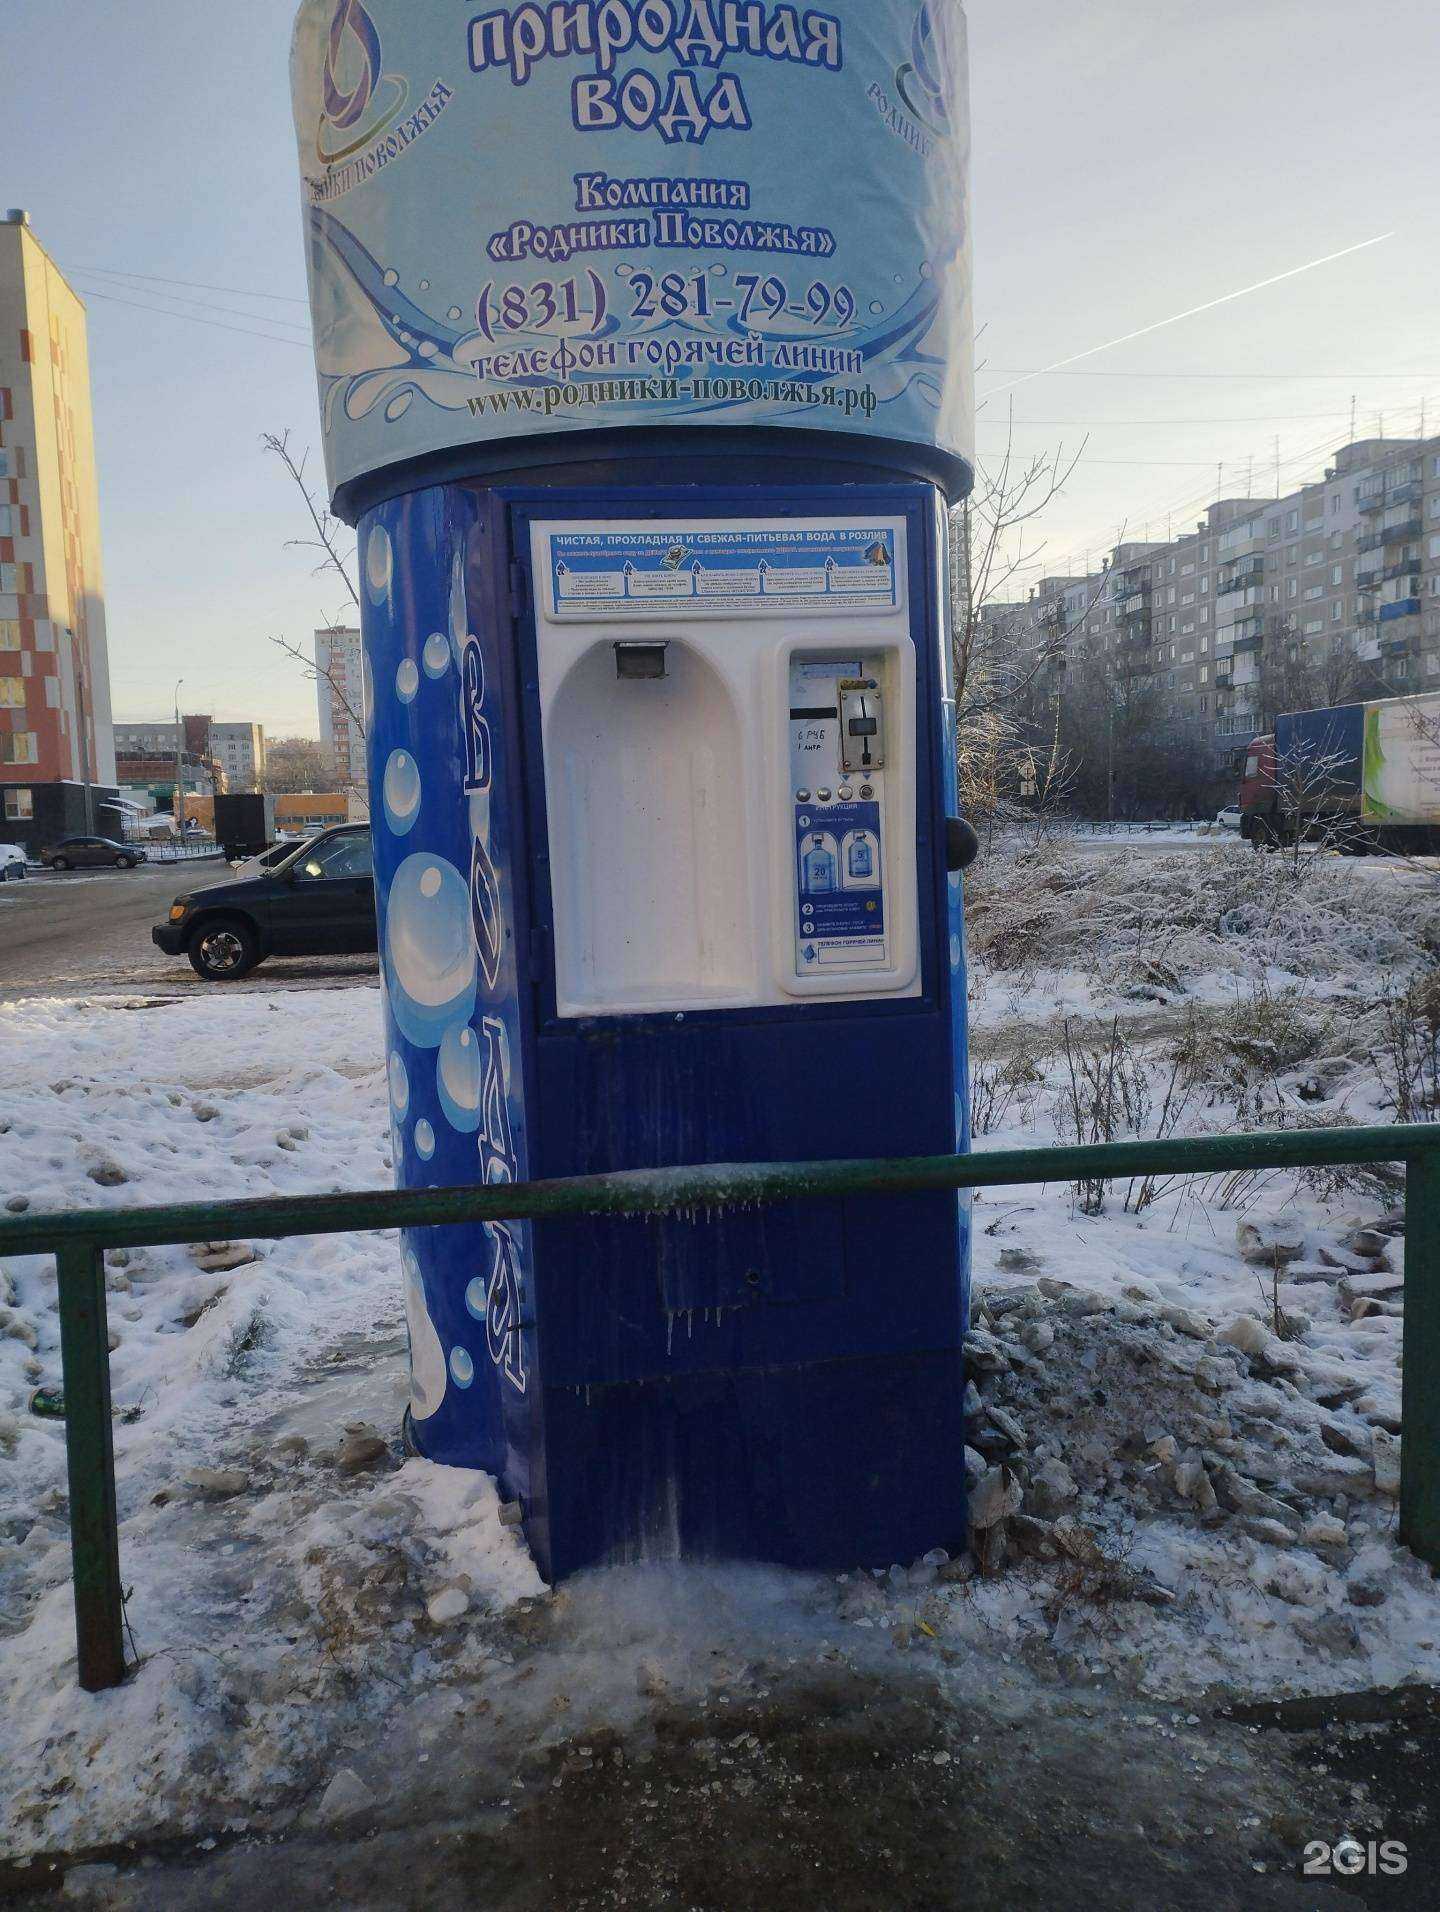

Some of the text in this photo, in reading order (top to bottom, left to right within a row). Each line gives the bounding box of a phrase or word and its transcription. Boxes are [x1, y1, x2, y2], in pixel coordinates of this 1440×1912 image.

[571, 68, 752, 145] вода
[574, 171, 751, 211] Компания
[486, 208, 837, 262] «Родники Поволжья»
[477, 269, 855, 343] (831) 281-79-99
[466, 377, 877, 418] www.родники-поволжья.рф
[556, 531, 888, 547] ЧИСТАЯ, ПРОХЛАДНАЯ И СВЕЖАЯ-ПИТЬЕВАЯ ВОДА В РОЗЛИВ
[814, 867, 826, 876] 20
